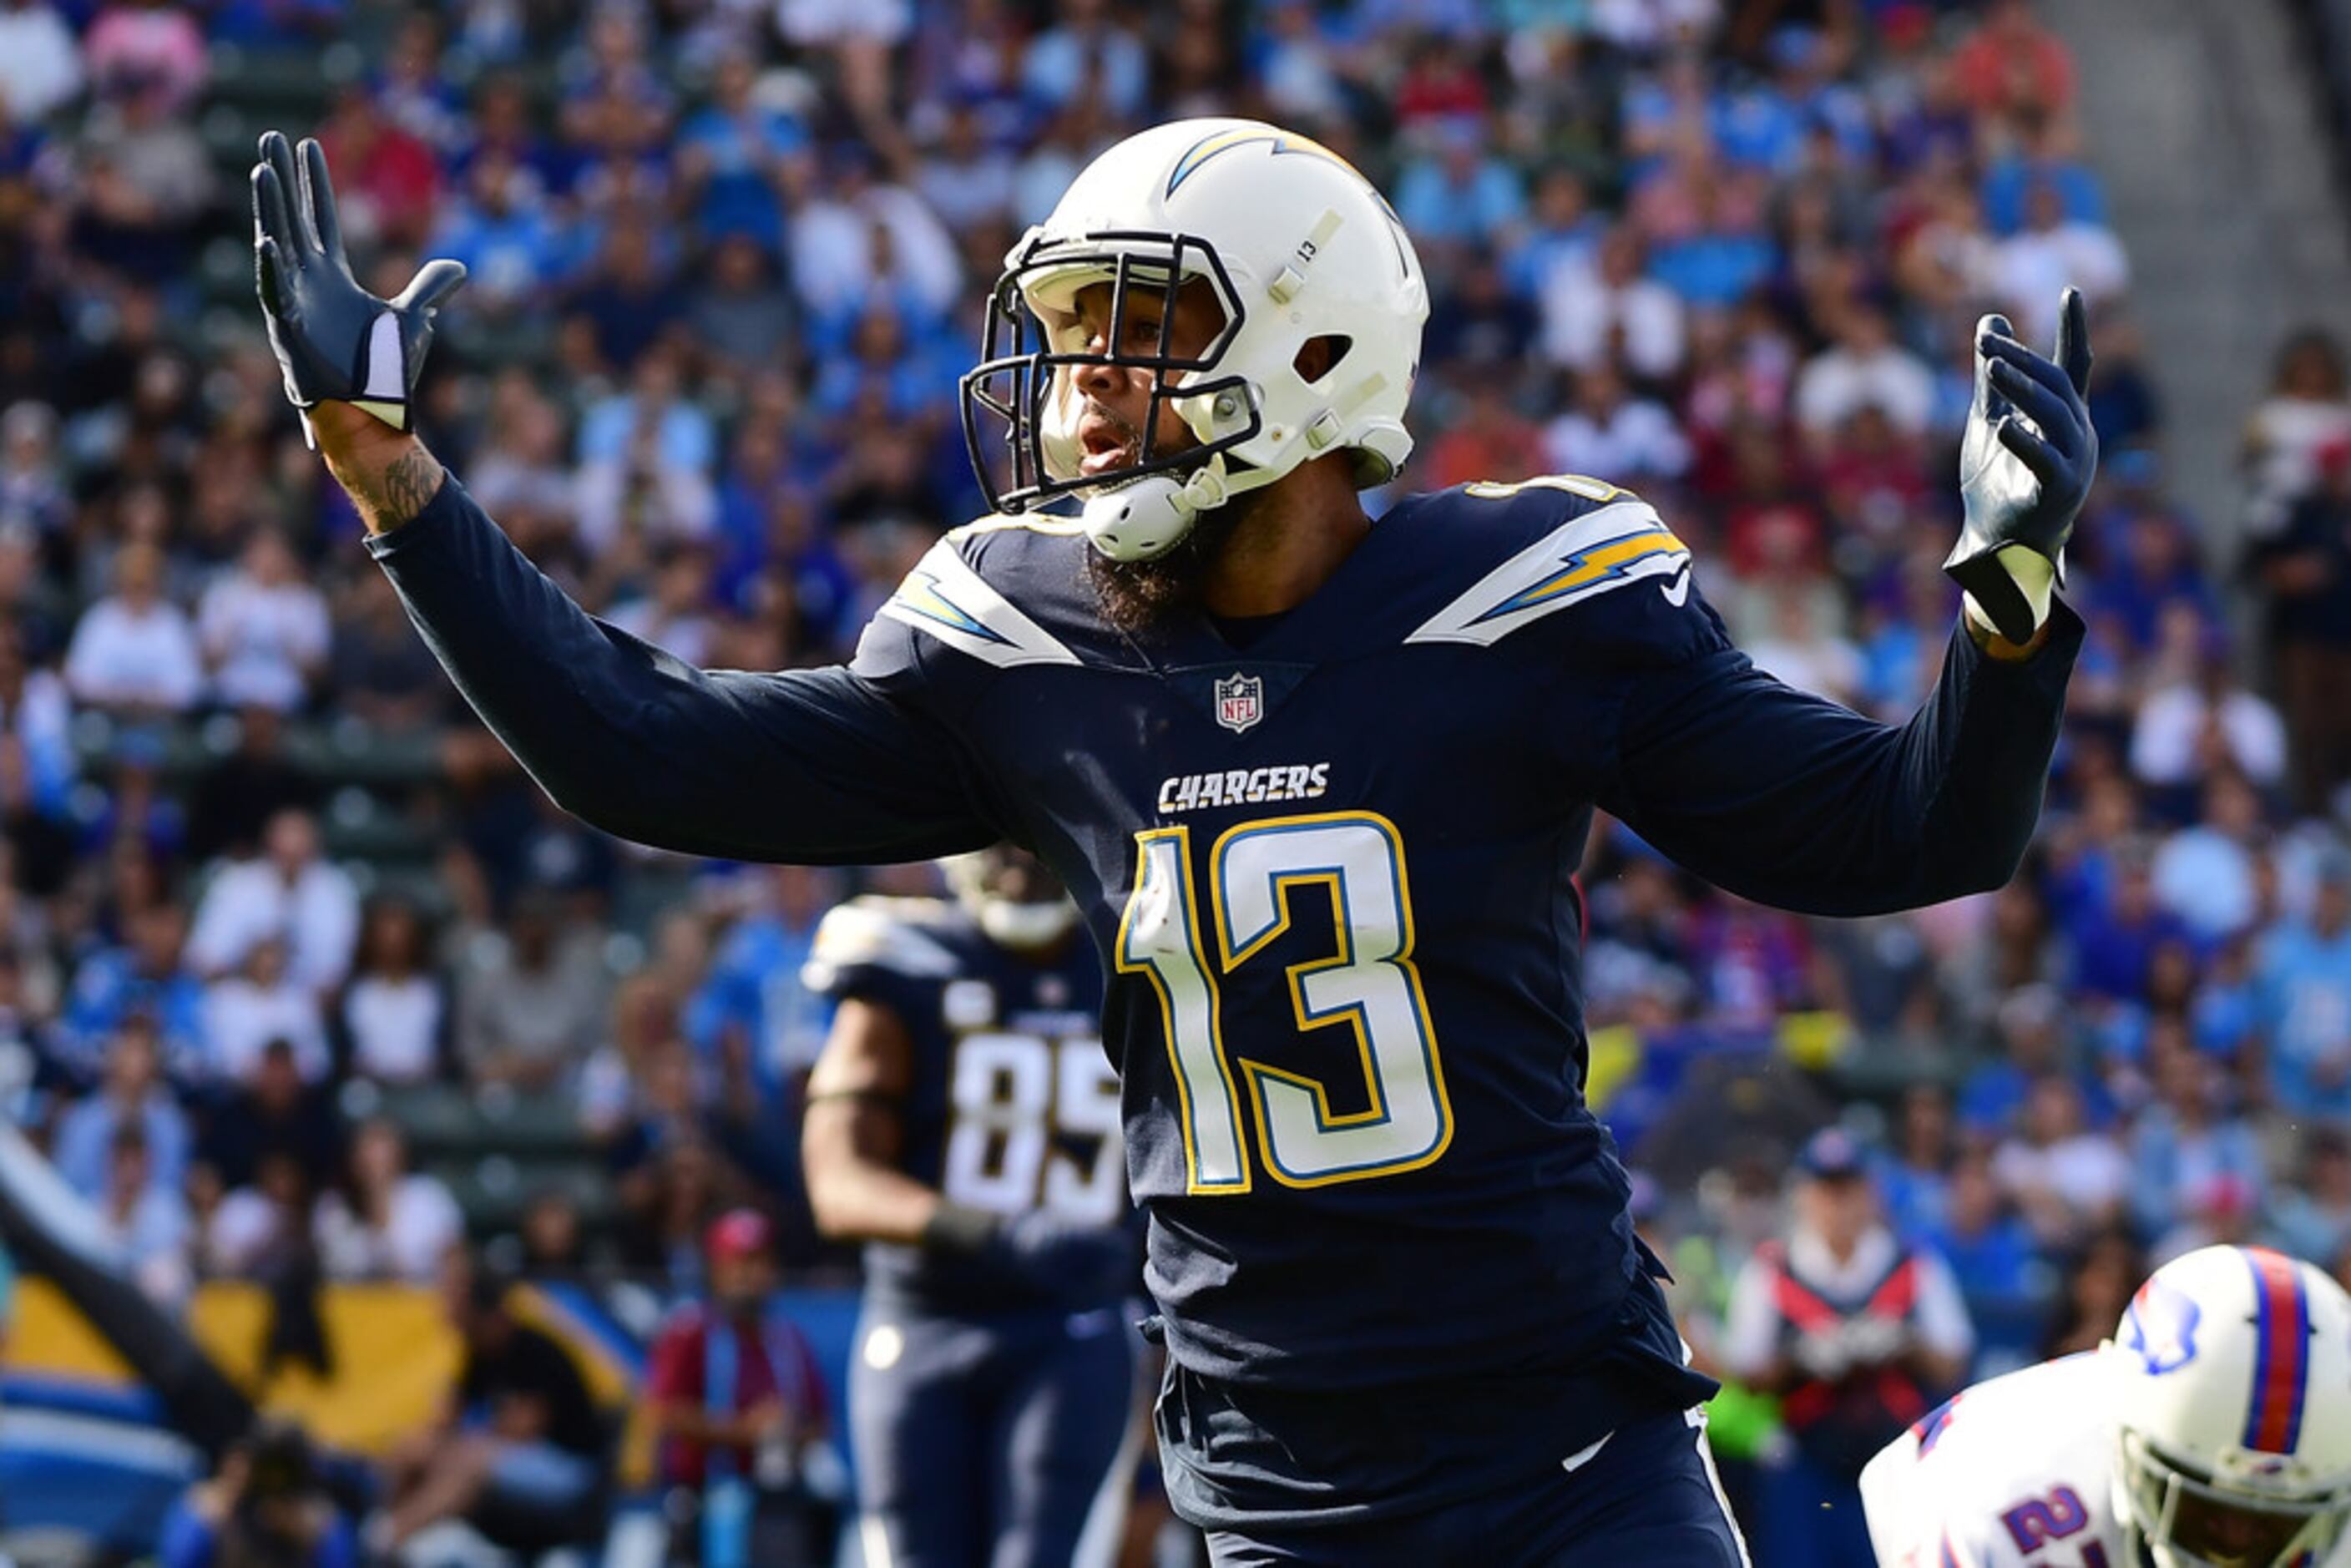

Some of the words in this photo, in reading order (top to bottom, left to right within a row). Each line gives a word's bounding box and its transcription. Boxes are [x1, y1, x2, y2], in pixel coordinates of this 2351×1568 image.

[1297, 240, 1317, 263] 13
[1224, 699, 1255, 721] NFL
[1157, 761, 1332, 814] CHARGERS
[1115, 810, 1454, 1196] 13
[943, 1029, 1124, 1229] 85
